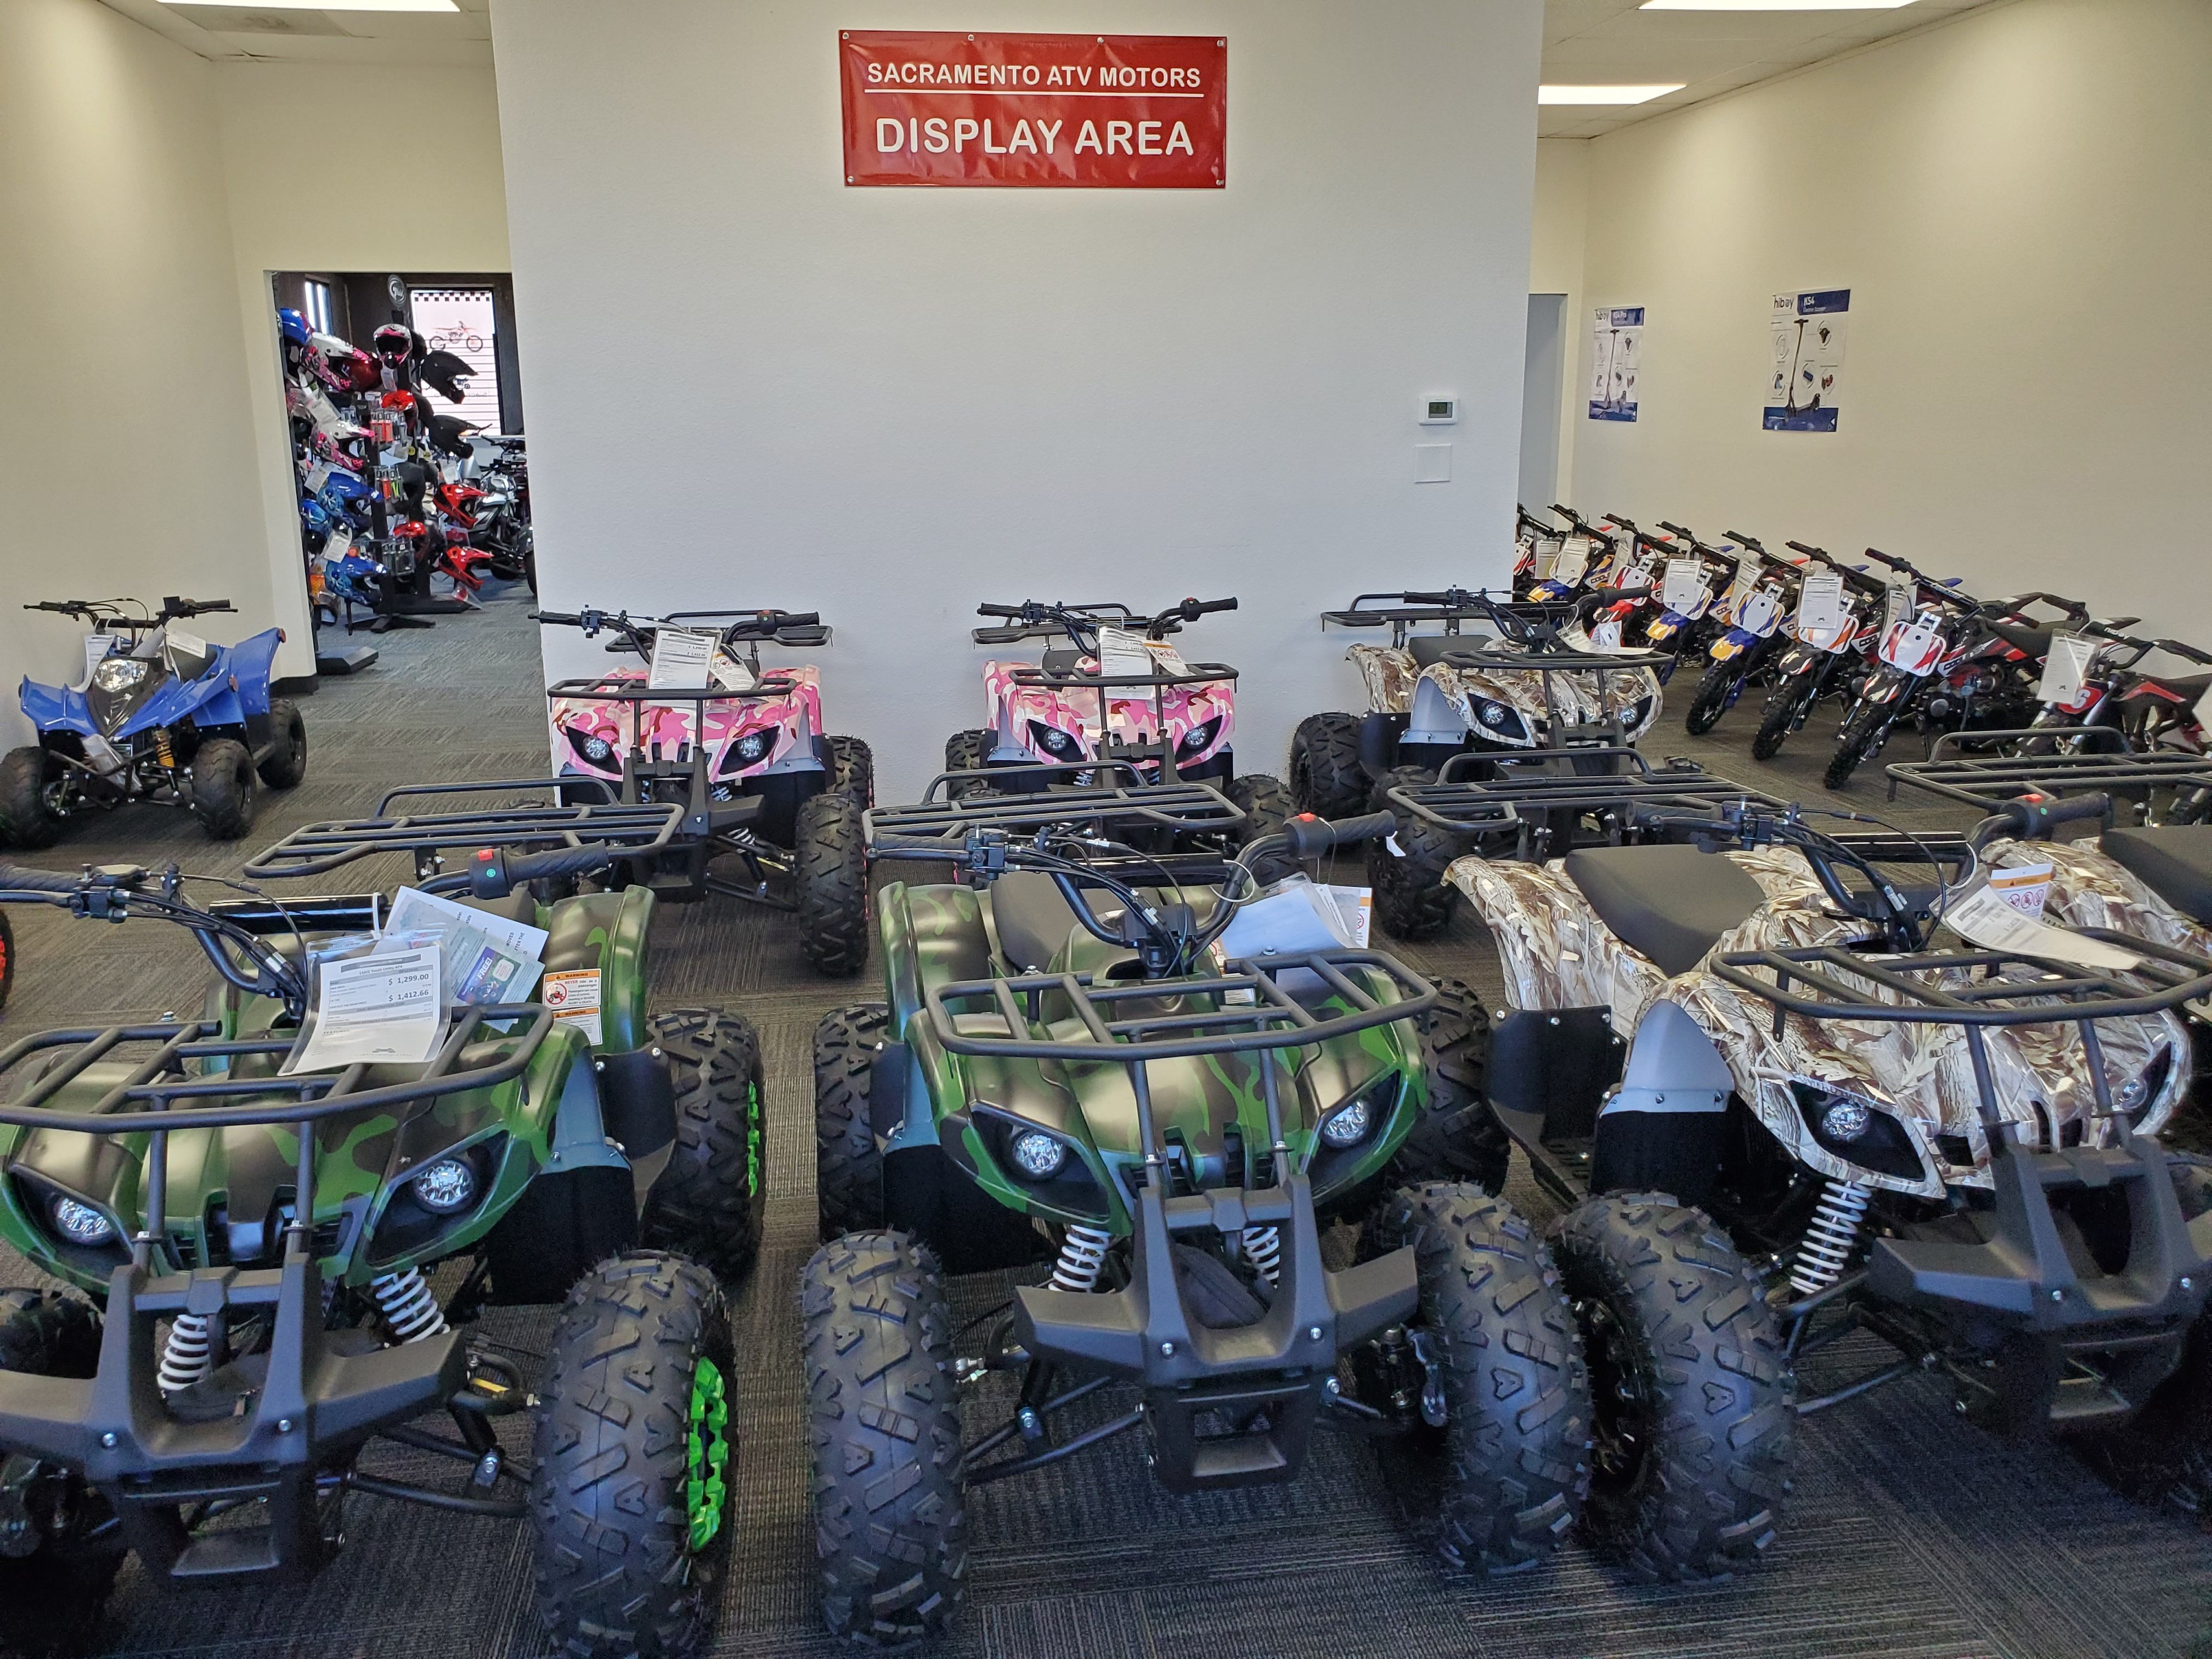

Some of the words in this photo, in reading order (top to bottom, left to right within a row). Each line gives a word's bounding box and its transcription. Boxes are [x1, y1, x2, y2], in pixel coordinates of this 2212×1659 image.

[867, 63, 1040, 86] SACRAMENTO
[1047, 65, 1092, 86] ATV
[1099, 67, 1201, 88] MOTORS
[876, 118, 1063, 154] DISPLAY
[1074, 120, 1194, 156] AREA
[397, 973, 429, 984] 1,299.00
[477, 957, 493, 980] FREE!
[398, 989, 429, 1000] 1,412.66
